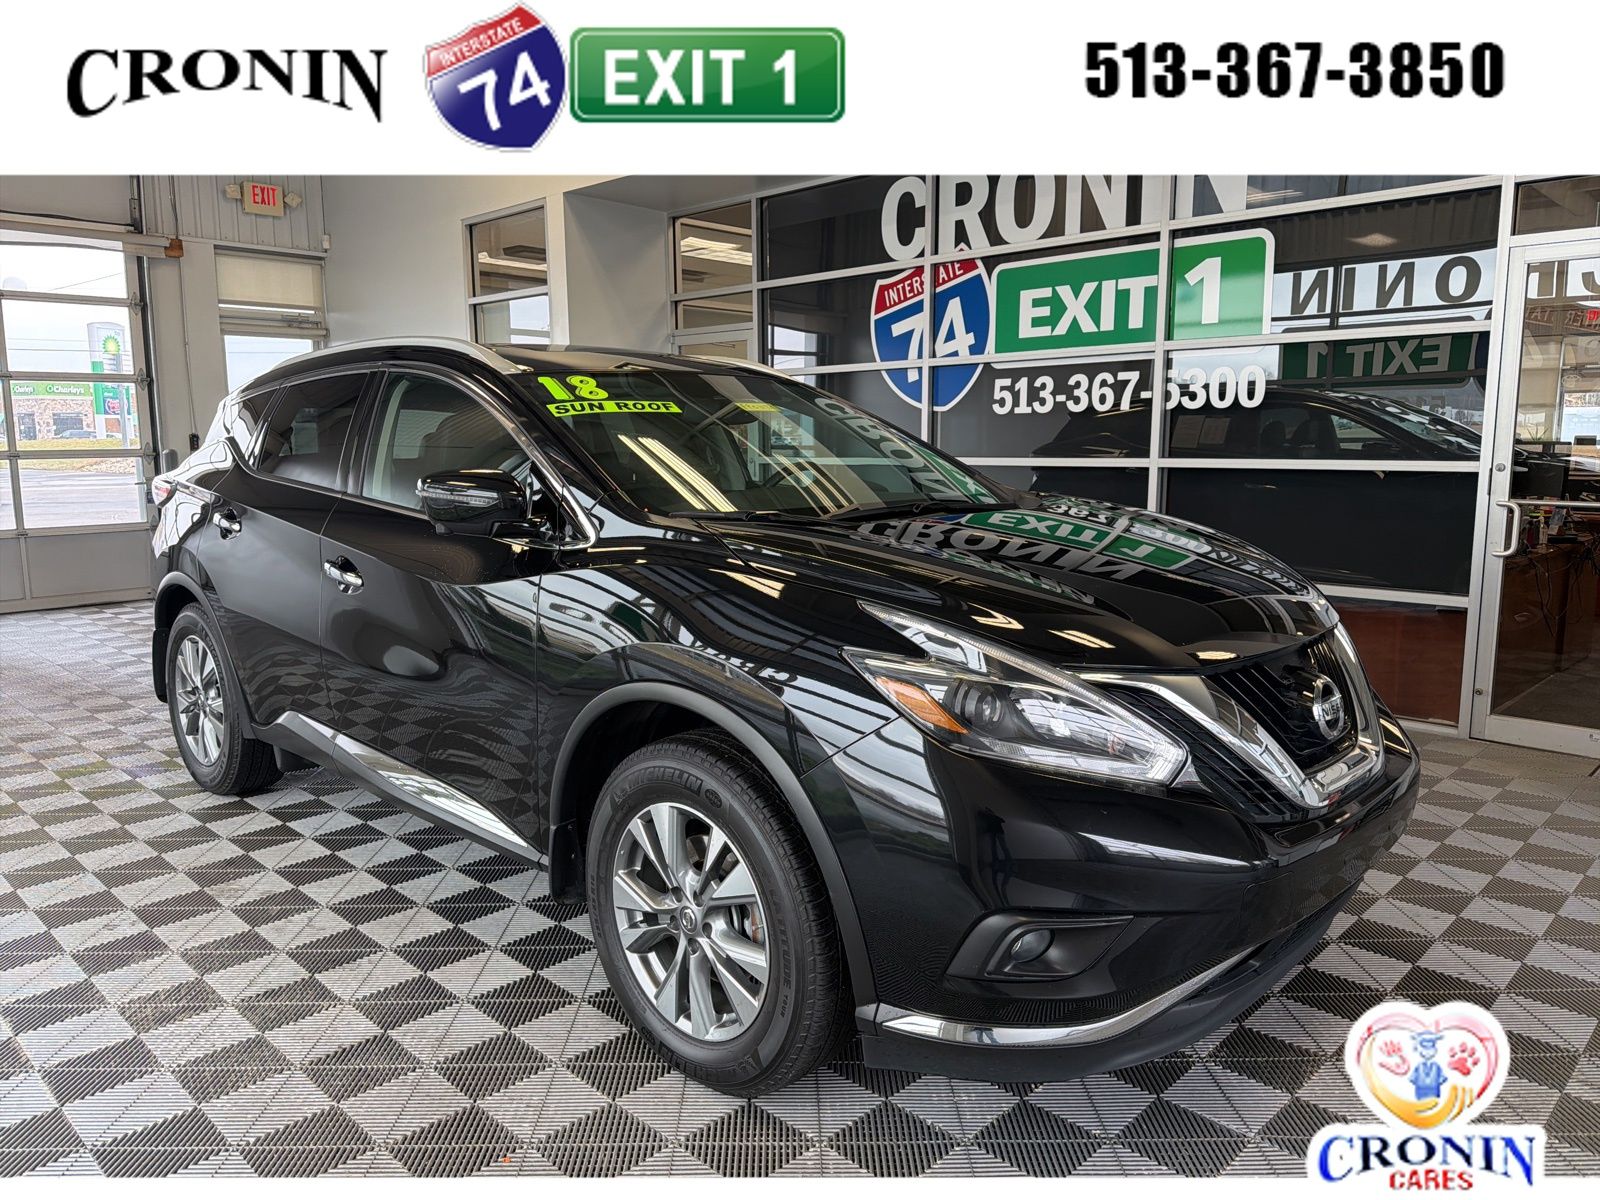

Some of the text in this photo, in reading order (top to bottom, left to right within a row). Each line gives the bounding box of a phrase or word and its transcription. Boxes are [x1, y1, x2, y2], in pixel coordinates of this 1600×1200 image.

[252, 184, 278, 207] EXIT
[884, 261, 964, 307] INTERATE
[1018, 256, 1222, 339] EXIT 1
[891, 296, 975, 384] 74
[537, 375, 609, 401] 18
[553, 401, 675, 415] SUN ROOF
[991, 365, 1266, 416] 513-367-5300
